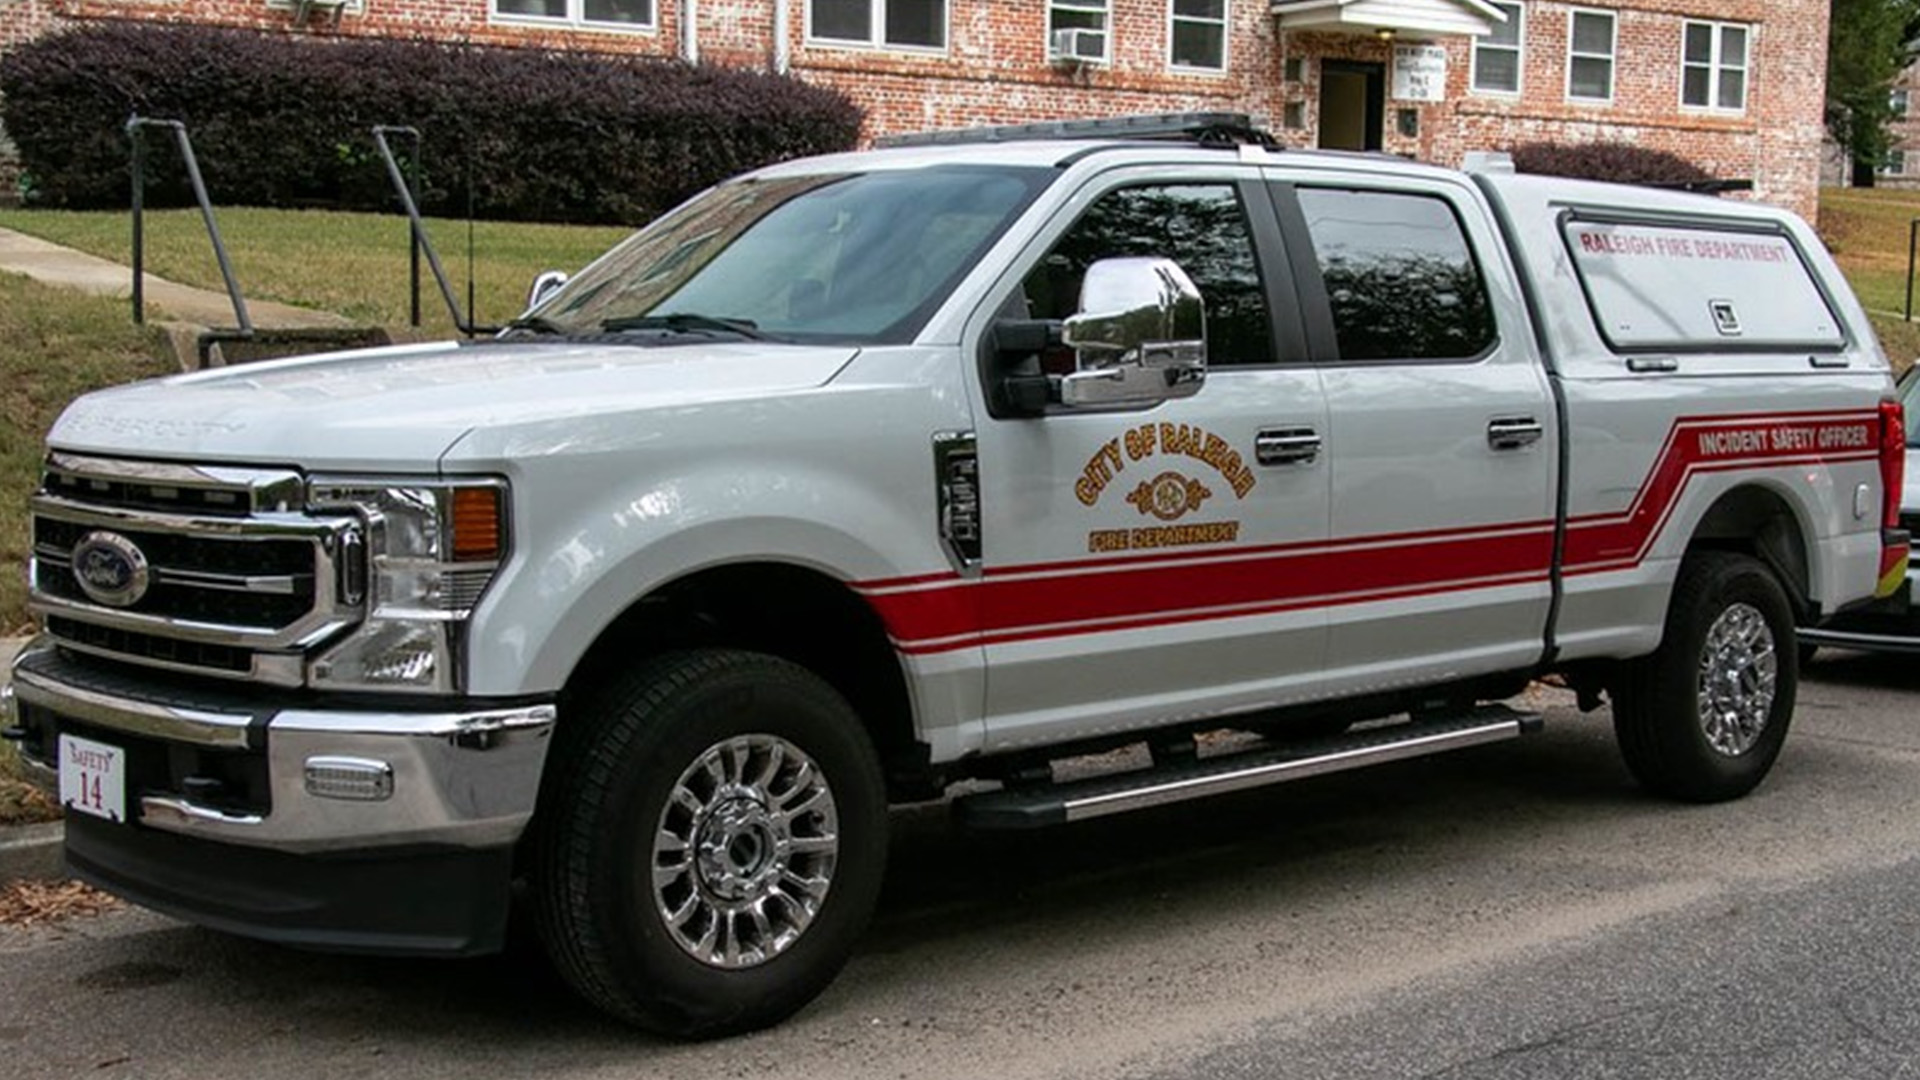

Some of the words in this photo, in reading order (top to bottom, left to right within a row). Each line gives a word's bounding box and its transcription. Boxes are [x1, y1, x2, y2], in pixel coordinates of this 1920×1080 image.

[1580, 232, 1652, 254] RALEIGH
[1657, 236, 1693, 257] FIRE
[1694, 240, 1788, 262] DEPARTMENT
[1699, 430, 1767, 455] INCIDENT
[1771, 427, 1816, 450] SAFETY
[1818, 425, 1868, 447] OFFICER
[1075, 437, 1124, 506] CITY
[1124, 423, 1156, 462] OF
[1159, 422, 1256, 499] RALEIGH
[1089, 529, 1129, 553] FIRE
[1131, 521, 1239, 548] DEPARTMENT
[71, 749, 110, 774] SAFETY
[81, 772, 102, 810] 14
